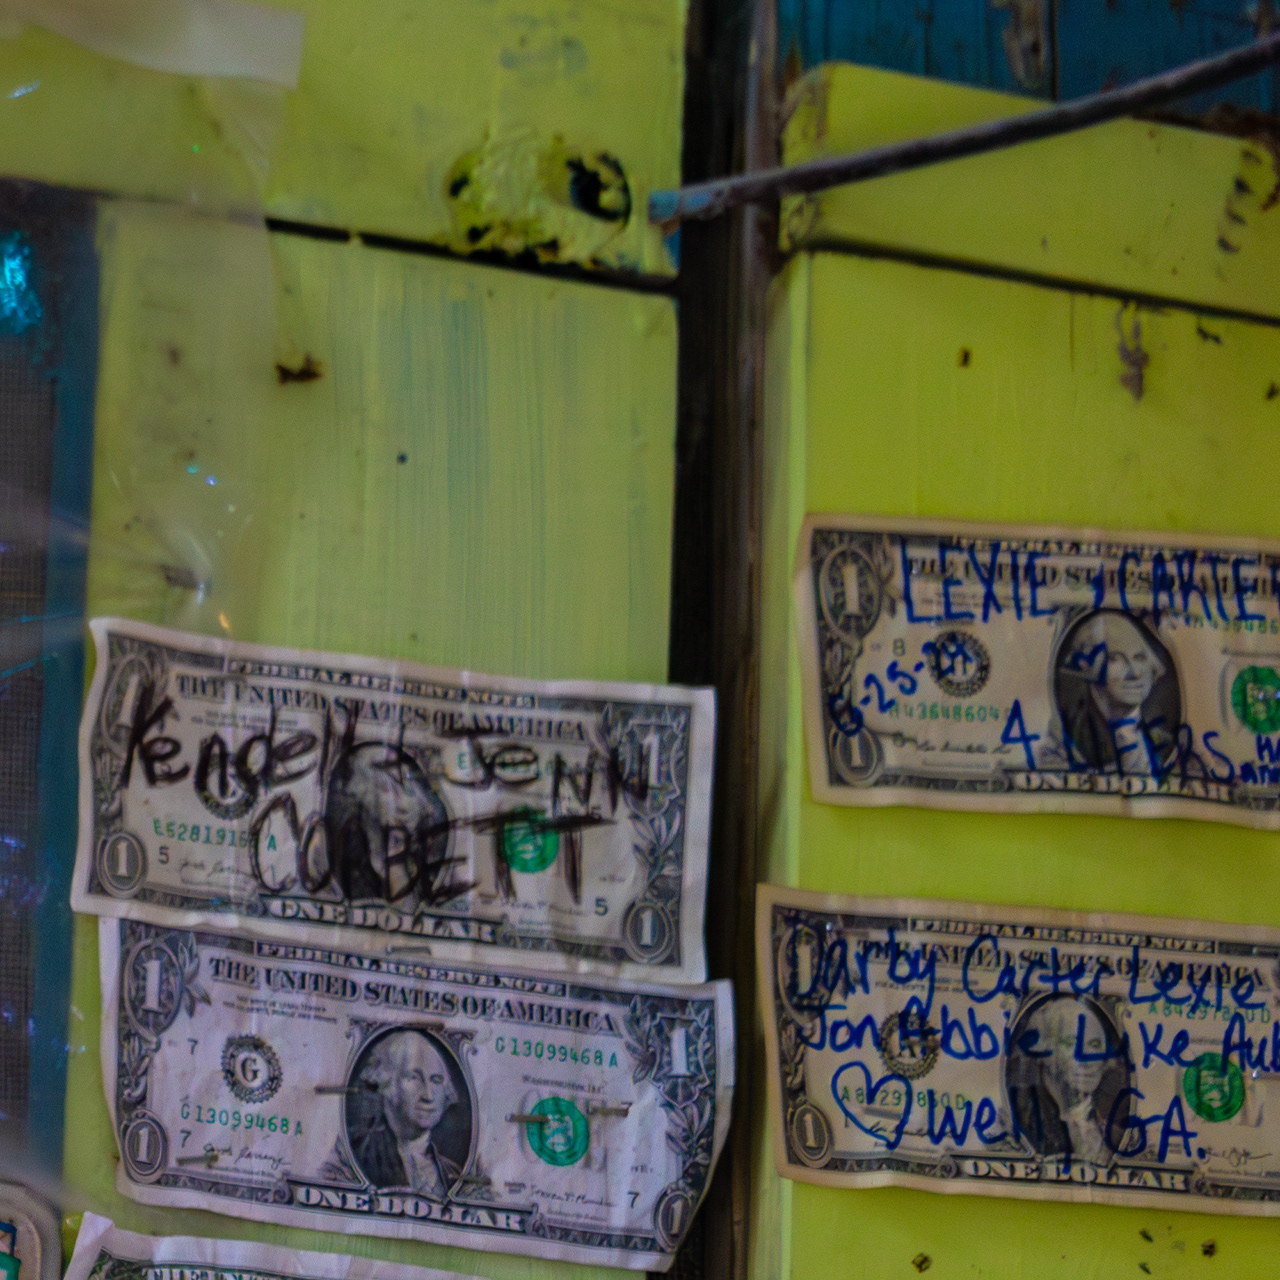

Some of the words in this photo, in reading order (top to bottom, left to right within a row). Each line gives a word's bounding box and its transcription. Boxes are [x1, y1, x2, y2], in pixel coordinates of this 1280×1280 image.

[900, 536, 1056, 622] LEXIE
[1120, 550, 1280, 623] CARTE
[209, 957, 260, 990] THE
[263, 967, 359, 1002] UNITED
[362, 980, 460, 1017] STATES
[462, 994, 500, 1018] OF
[497, 1000, 620, 1036] AMERICA
[240, 1058, 262, 1083] G
[297, 1186, 374, 1212] ONE
[377, 1196, 523, 1232] DOLLAR
